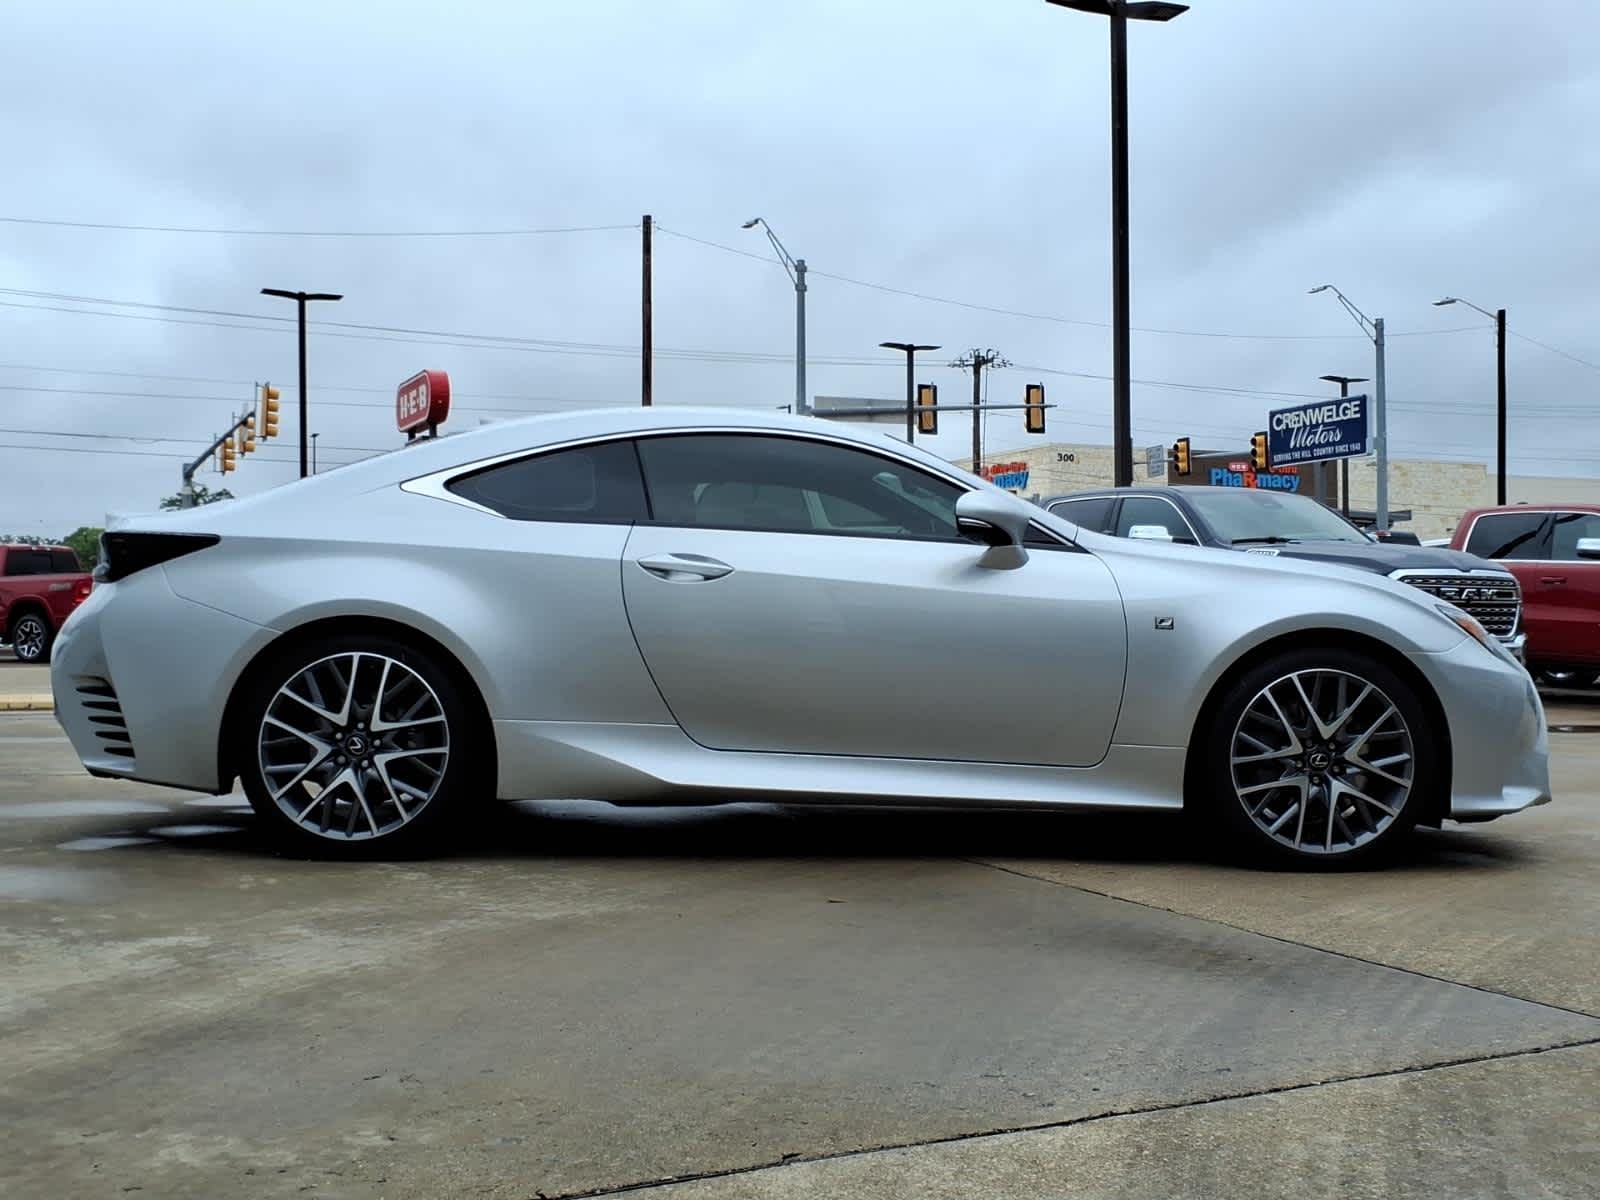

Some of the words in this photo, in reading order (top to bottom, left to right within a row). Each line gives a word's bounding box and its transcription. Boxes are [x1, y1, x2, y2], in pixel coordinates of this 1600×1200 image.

[1273, 401, 1361, 430] CRENWELGE
[1290, 424, 1342, 449] Motors
[1057, 453, 1075, 462] 300
